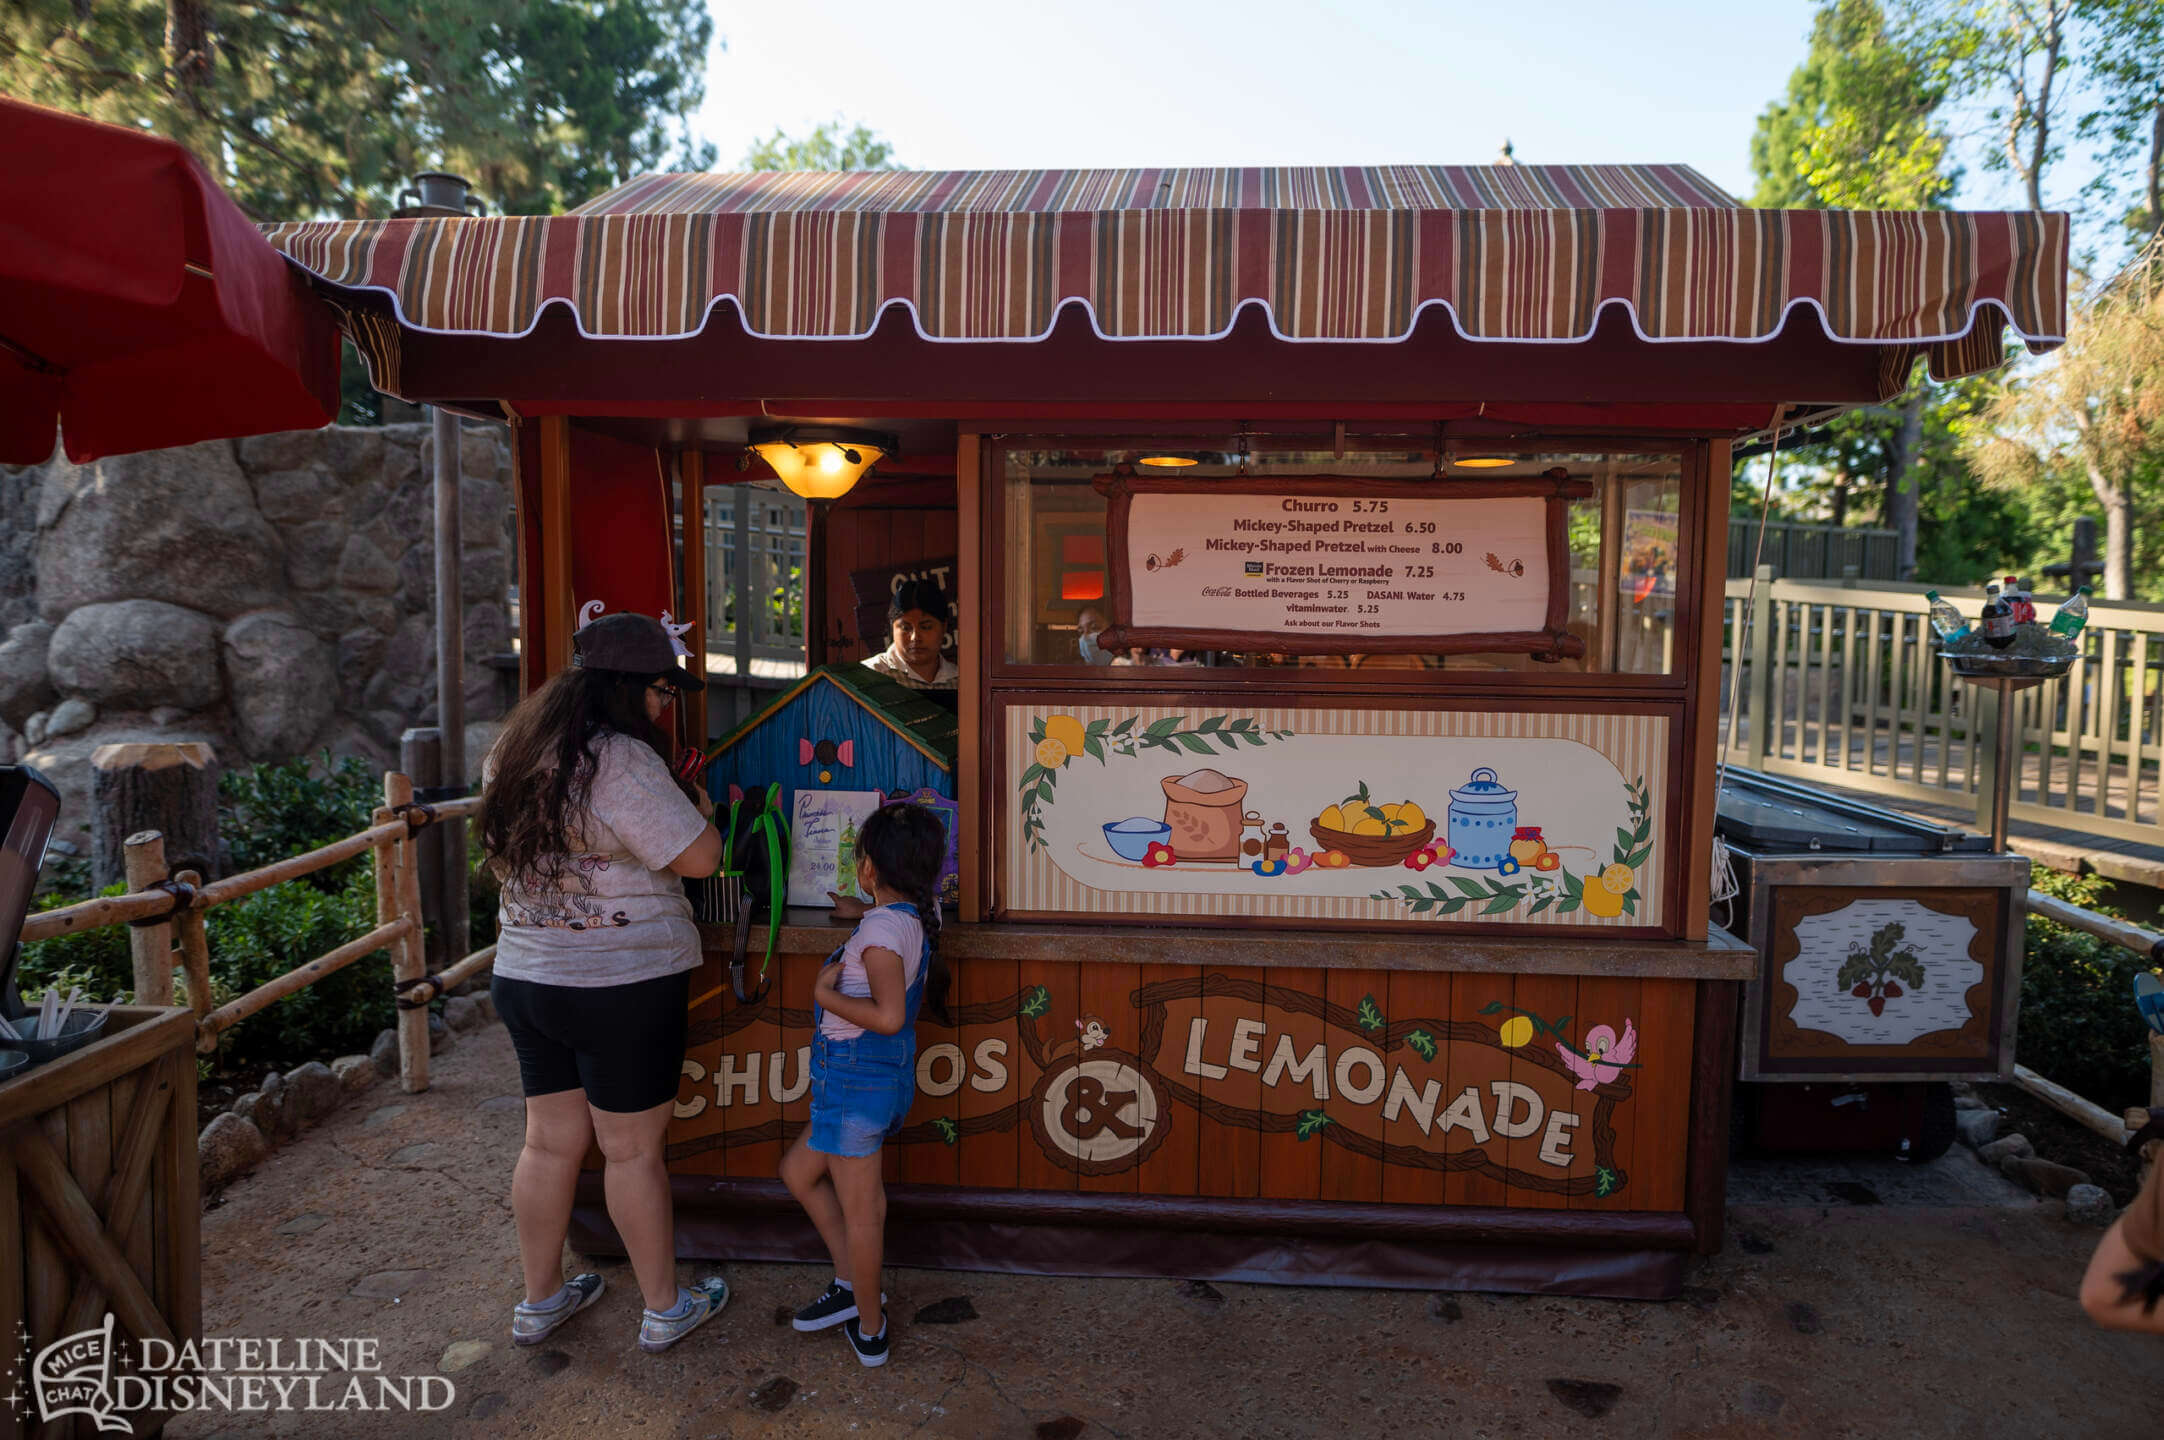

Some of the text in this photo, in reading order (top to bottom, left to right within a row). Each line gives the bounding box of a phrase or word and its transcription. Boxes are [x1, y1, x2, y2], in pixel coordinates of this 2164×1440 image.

[1281, 498, 1388, 513] Churro 5.75
[1233, 519, 1436, 535] Mickey-Shaped Pretzel 6.50
[1205, 538, 1463, 554] Mickey-Shaped Pretzel with Cheese 8.00
[1265, 562, 1315, 576] Frozen
[1318, 564, 1393, 577] Lemonade
[1404, 566, 1434, 578] 7.25
[1329, 578, 1349, 586] Cherry
[1358, 578, 1389, 586] Raspberry
[1234, 588, 1269, 598] Bottled
[1271, 589, 1319, 600] Beverages
[1327, 590, 1349, 599] 5.25
[1366, 590, 1403, 600] DASANI
[1406, 592, 1436, 601] Water
[1442, 592, 1465, 601] 4.75
[1286, 603, 1379, 614] vitaminwater 5.25
[1284, 619, 1298, 627] Ask
[1335, 620, 1358, 628] Flavor
[1359, 620, 1380, 628] Shots
[673, 1016, 1581, 1168] CHUOS & LEMONADE
